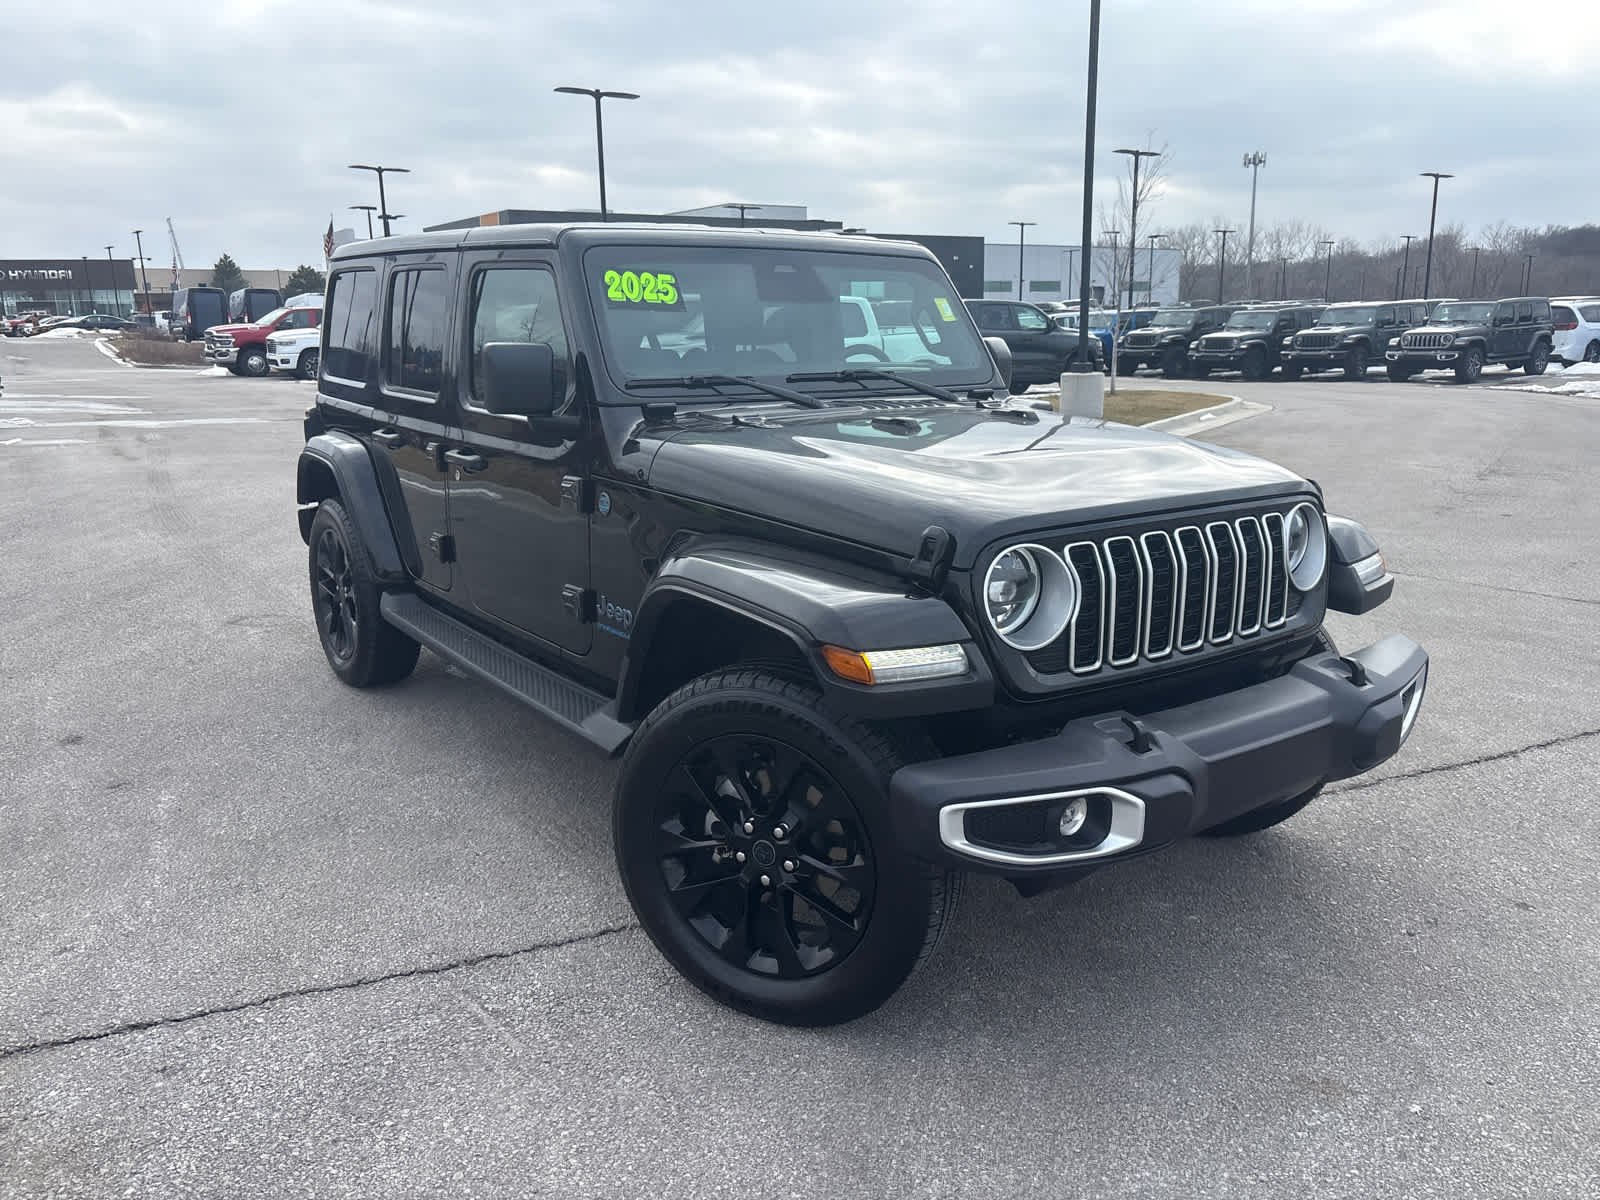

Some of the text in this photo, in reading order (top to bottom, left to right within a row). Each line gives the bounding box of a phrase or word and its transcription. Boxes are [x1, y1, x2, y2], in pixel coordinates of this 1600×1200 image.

[8, 269, 73, 280] HYUNDAI
[604, 270, 678, 304] 2025
[596, 595, 633, 630] Jeep
